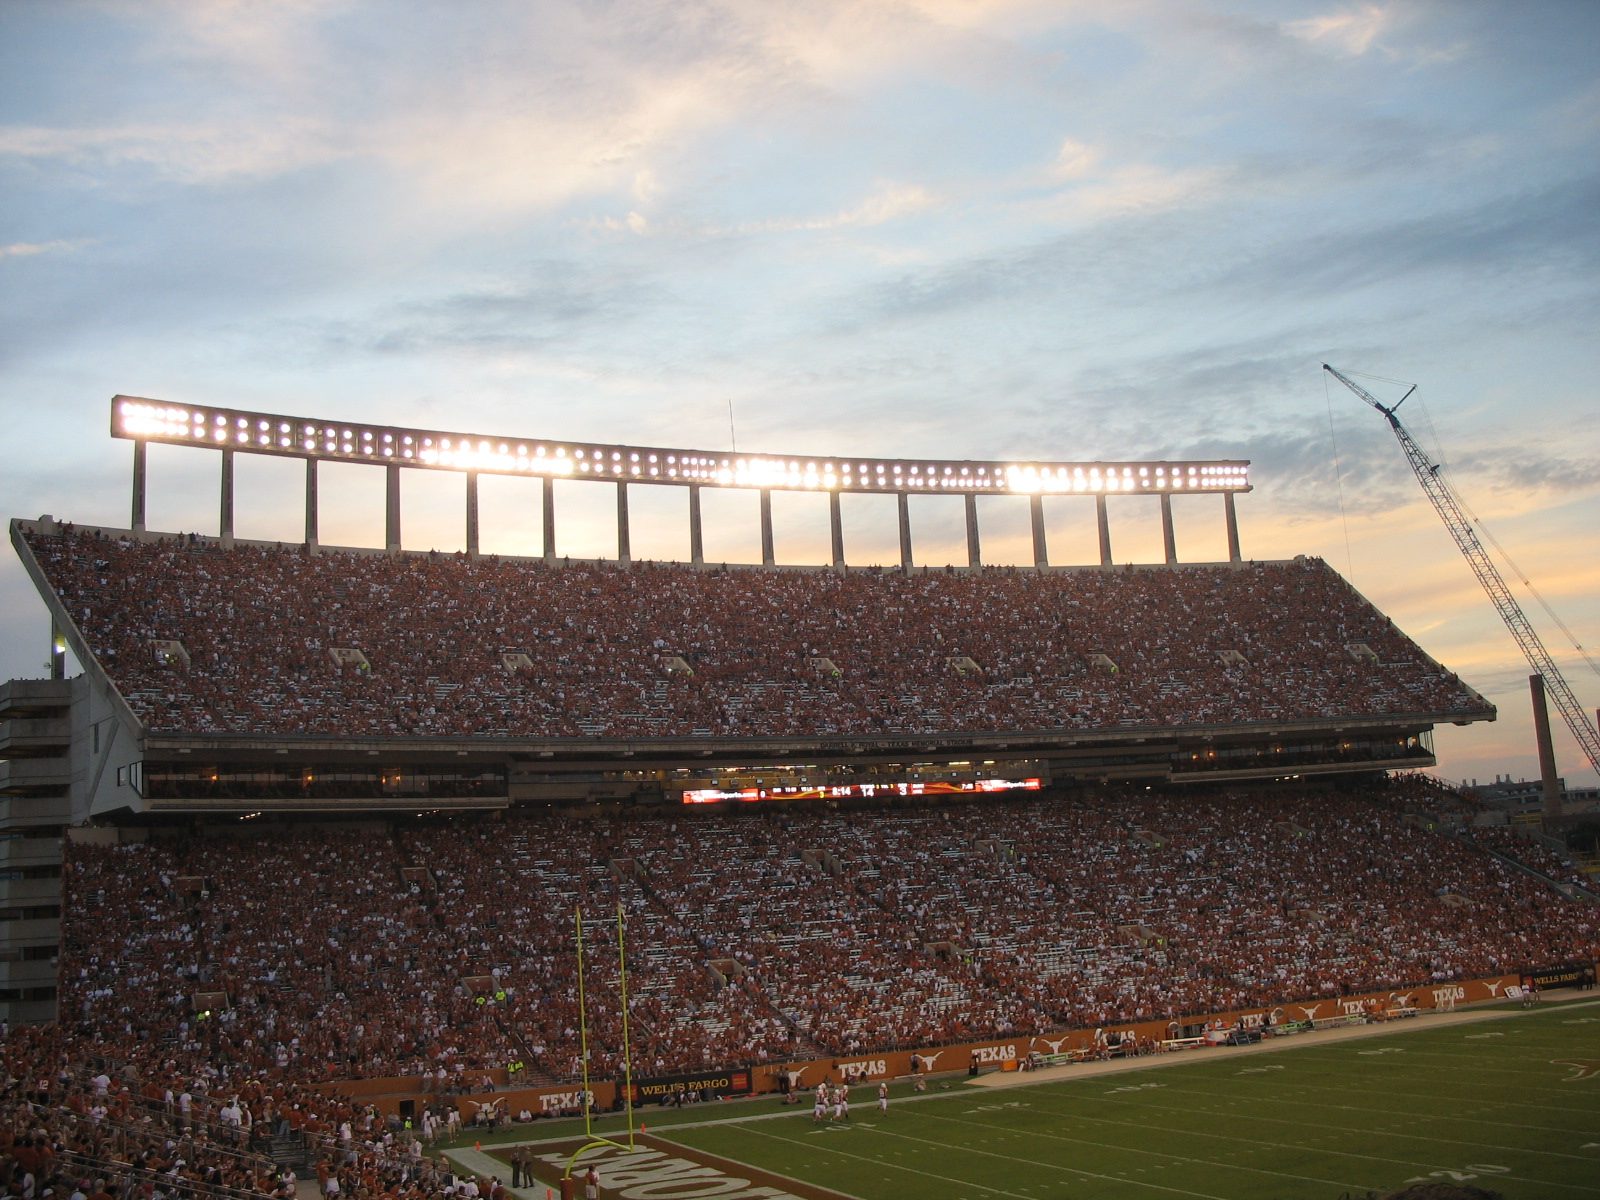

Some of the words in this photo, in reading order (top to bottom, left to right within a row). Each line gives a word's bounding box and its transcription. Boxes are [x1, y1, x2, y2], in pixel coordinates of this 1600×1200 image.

[861, 788, 874, 797] 14
[1534, 975, 1559, 985] WELLS
[1432, 986, 1465, 1002] TEXAS
[1241, 1012, 1277, 1027] TEXS
[972, 1045, 1016, 1062] TEXAS
[838, 1060, 886, 1078] TEXAS
[641, 1082, 685, 1096] WELLS
[688, 1078, 728, 1090] FARGO
